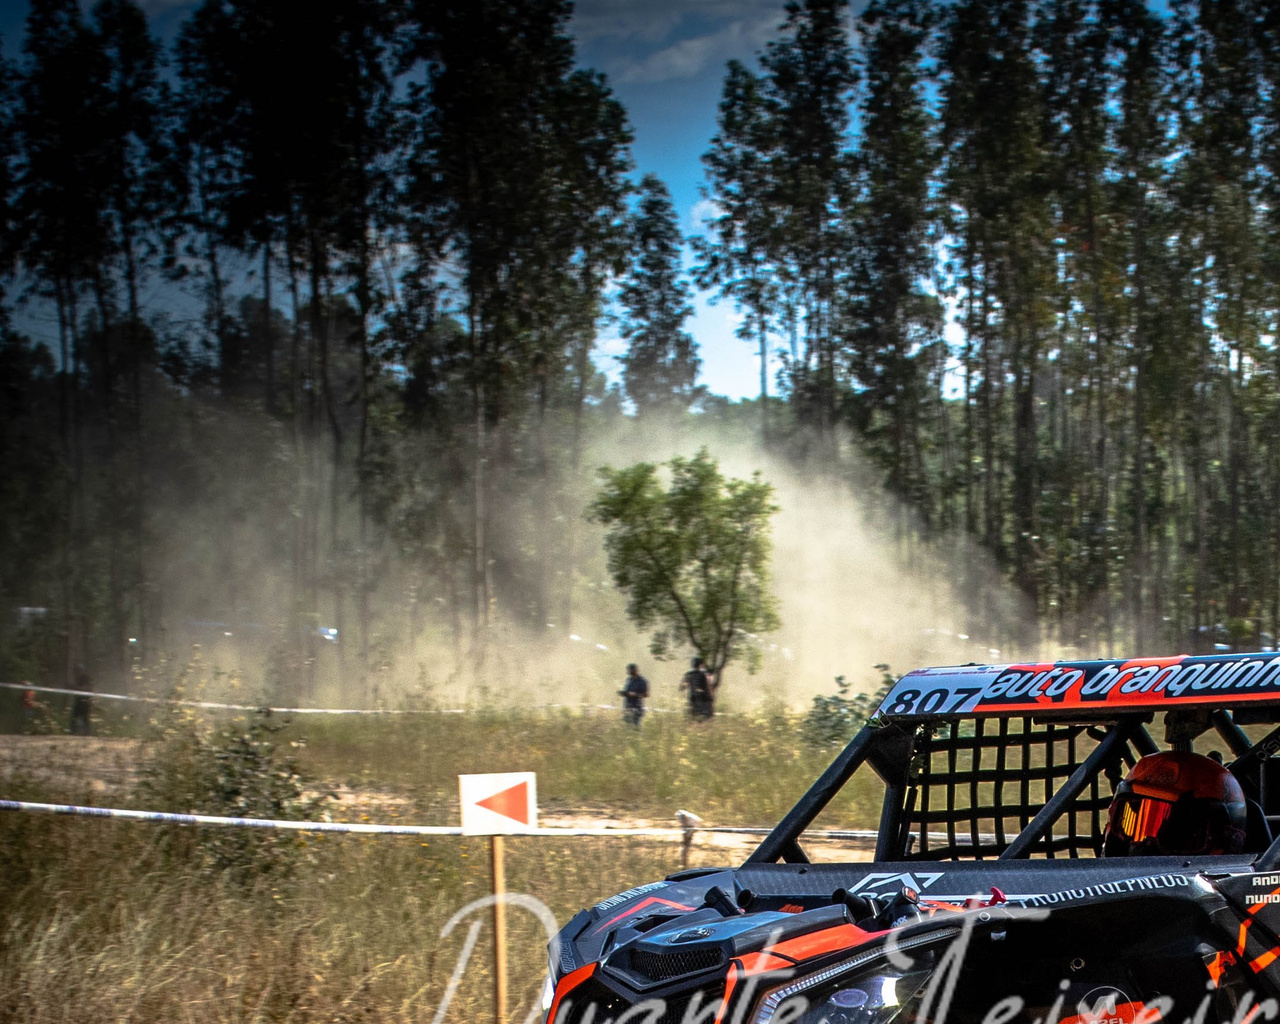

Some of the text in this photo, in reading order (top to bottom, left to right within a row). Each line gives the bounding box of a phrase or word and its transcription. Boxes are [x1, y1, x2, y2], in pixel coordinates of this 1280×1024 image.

[983, 666, 1082, 701] auto
[886, 688, 982, 714] 807
[1245, 893, 1280, 904] NUNO
